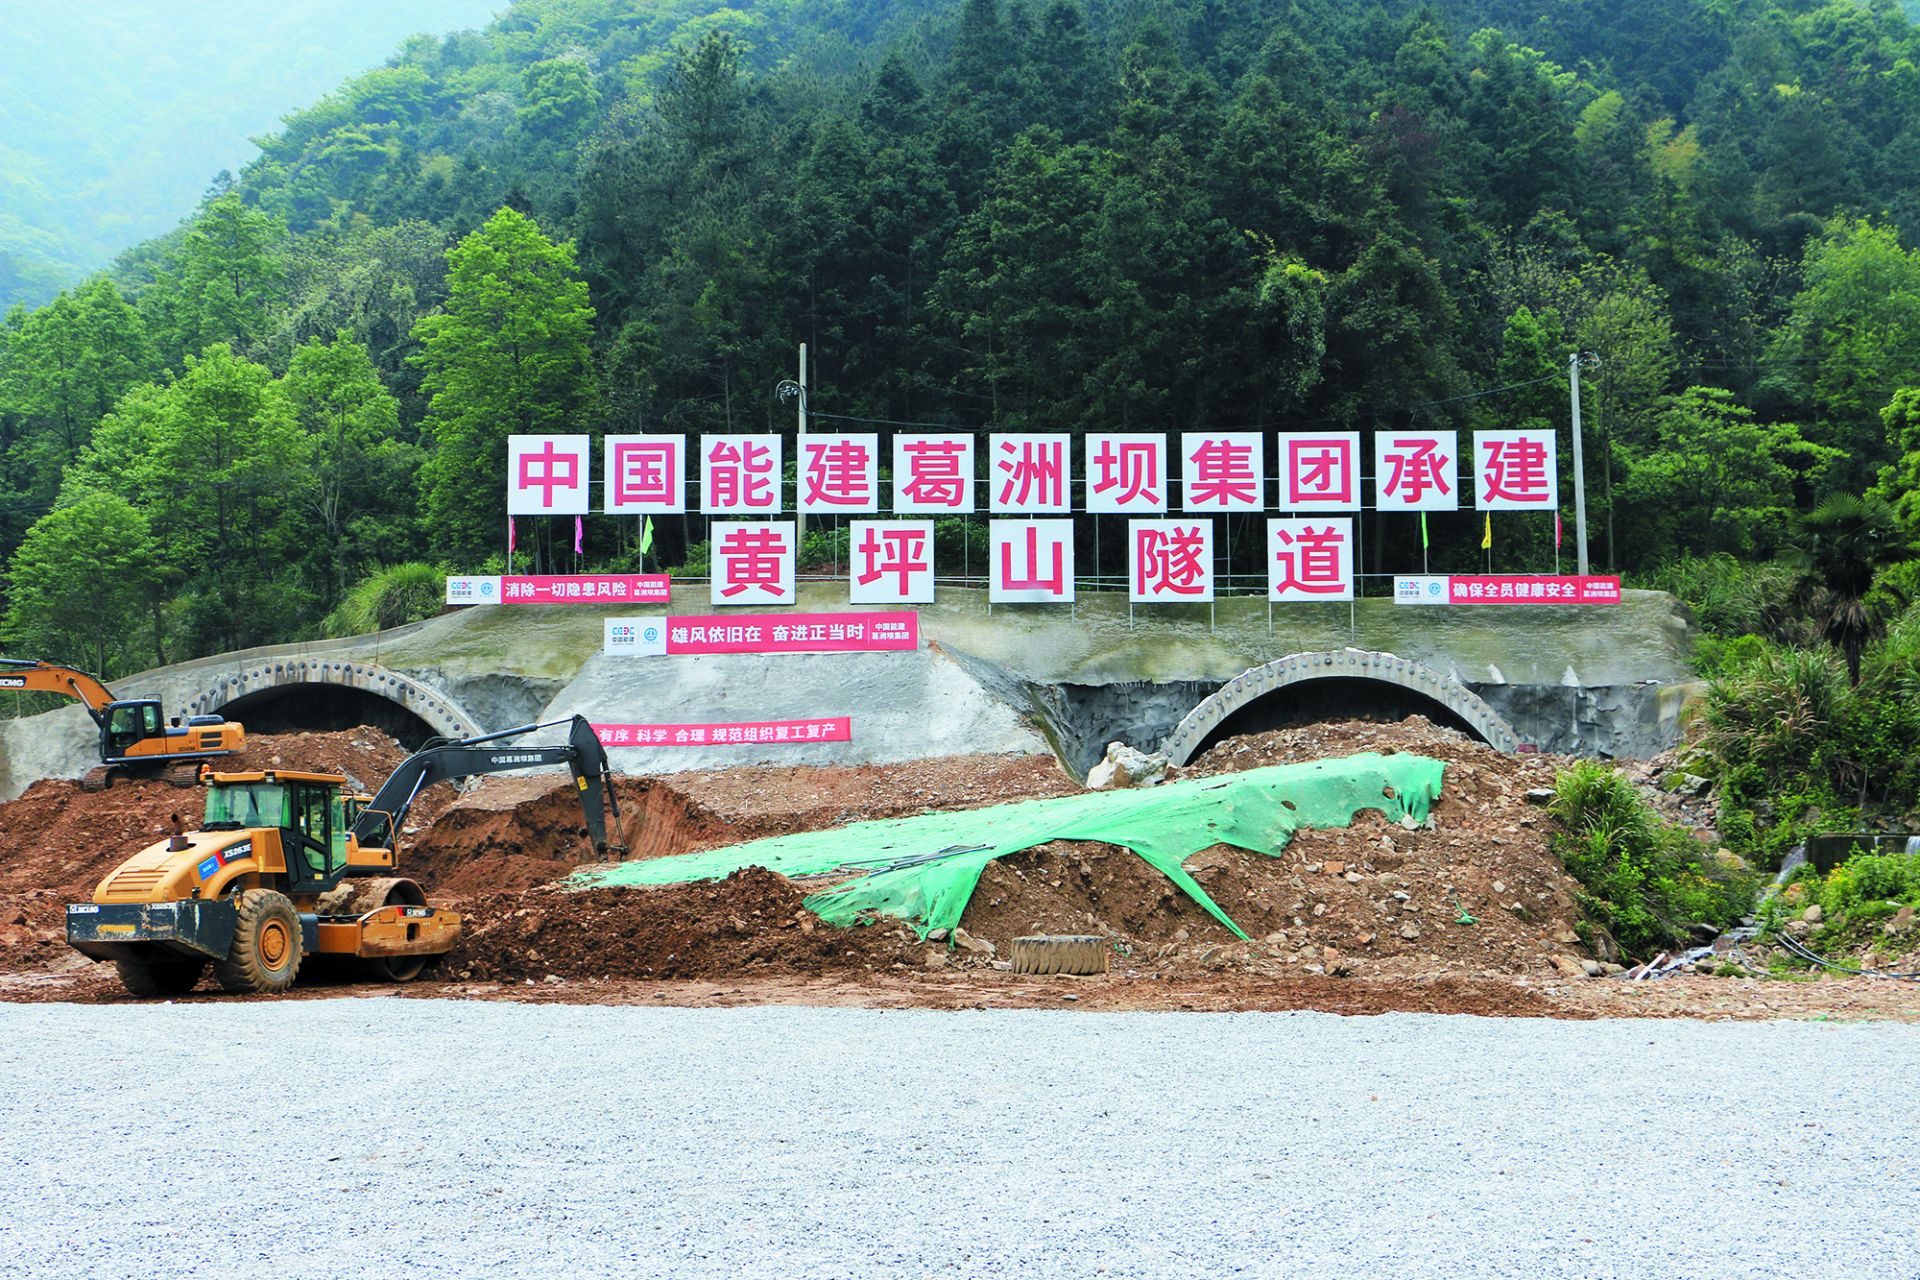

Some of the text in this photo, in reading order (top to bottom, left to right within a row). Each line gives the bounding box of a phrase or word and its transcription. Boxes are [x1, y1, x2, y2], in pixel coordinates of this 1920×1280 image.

[519, 436, 1549, 508] 中国能建葛洲坝集团承建
[719, 525, 1346, 597] 黄坪山隧道
[505, 581, 627, 597] 消除一切隐患风险
[1453, 582, 1576, 598] 确保全员健康安全
[671, 622, 865, 644] 雄风依旧在 奋进正当时
[599, 722, 837, 743] 有序 科学 合理 规范组织复工复产
